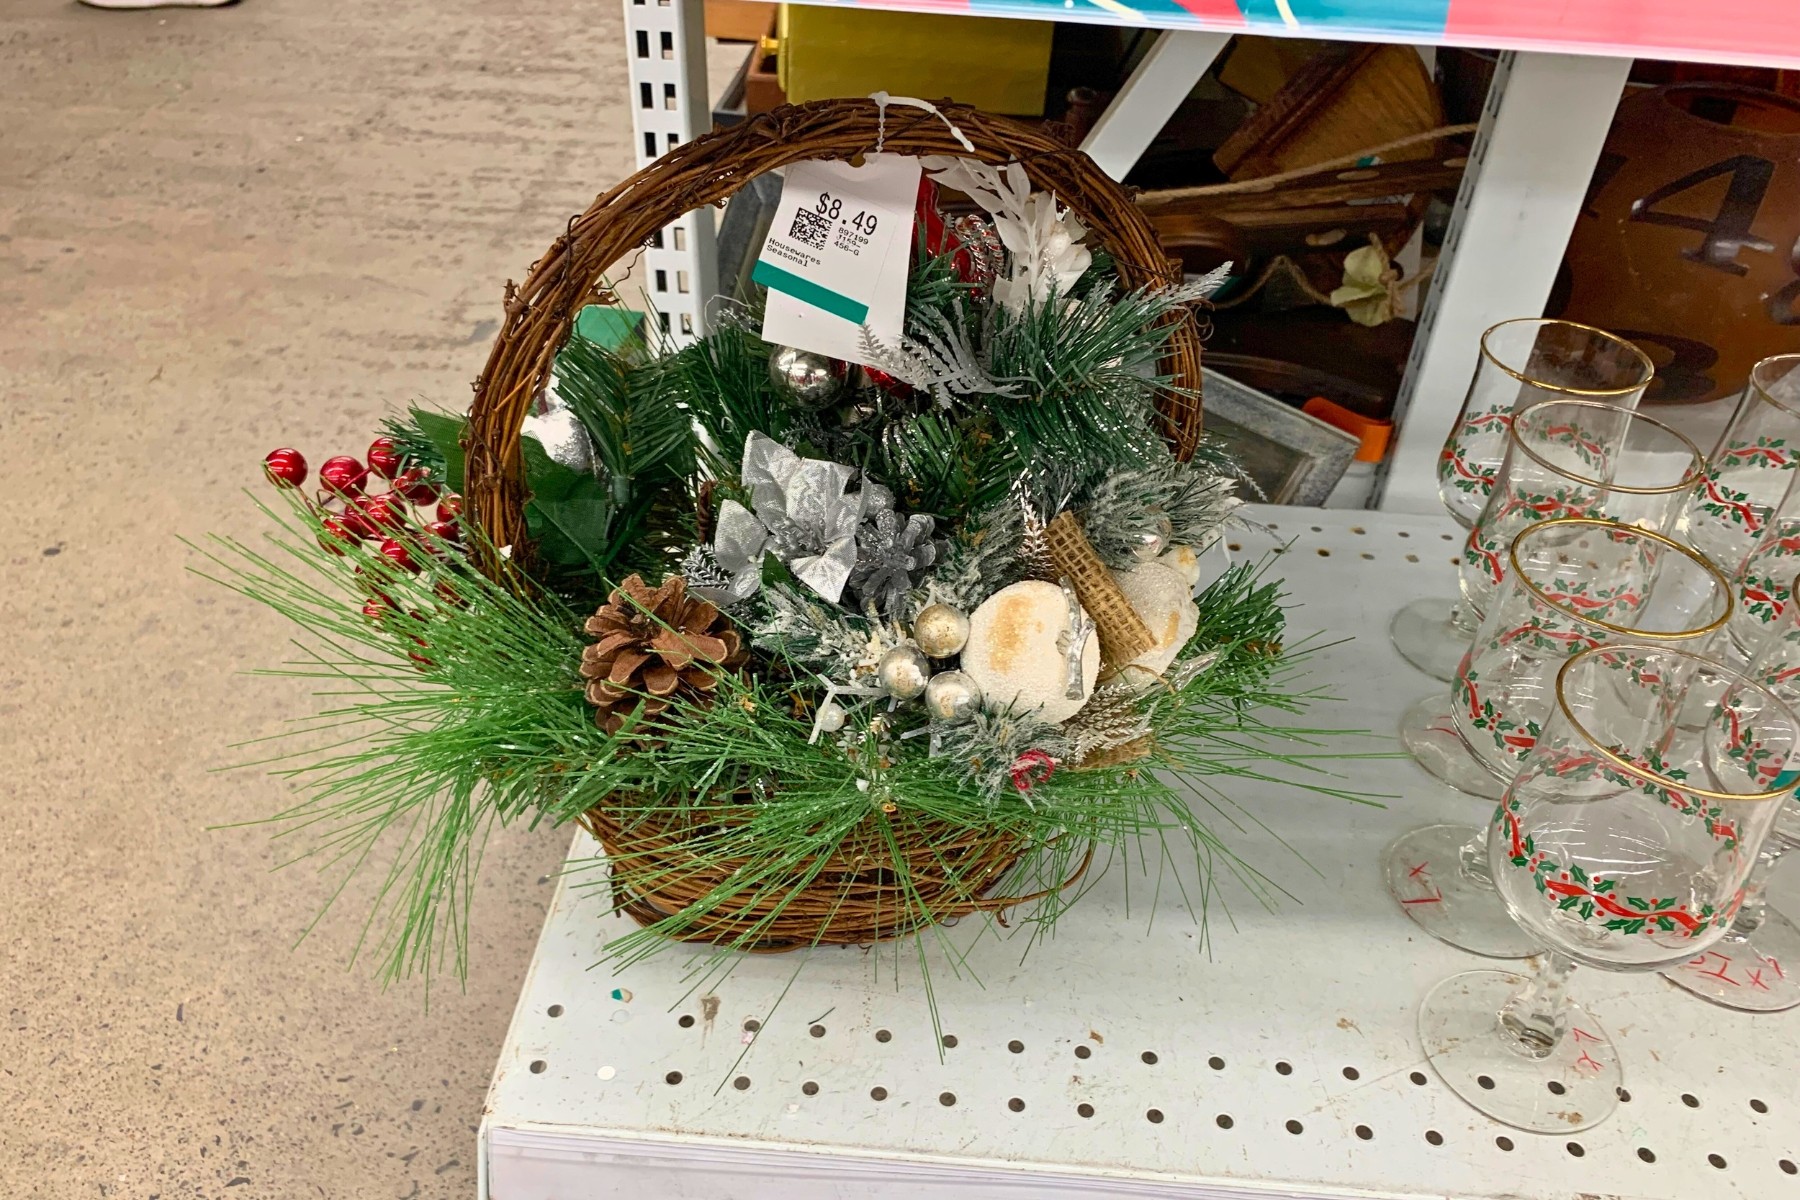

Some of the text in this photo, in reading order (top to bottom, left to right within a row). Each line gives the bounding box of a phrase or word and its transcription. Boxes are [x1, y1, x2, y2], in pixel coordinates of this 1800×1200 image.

[816, 191, 878, 236] $8.49
[1628, 153, 1777, 279] 4
[766, 245, 808, 267] Seasonal
[769, 237, 821, 265] Housewares
